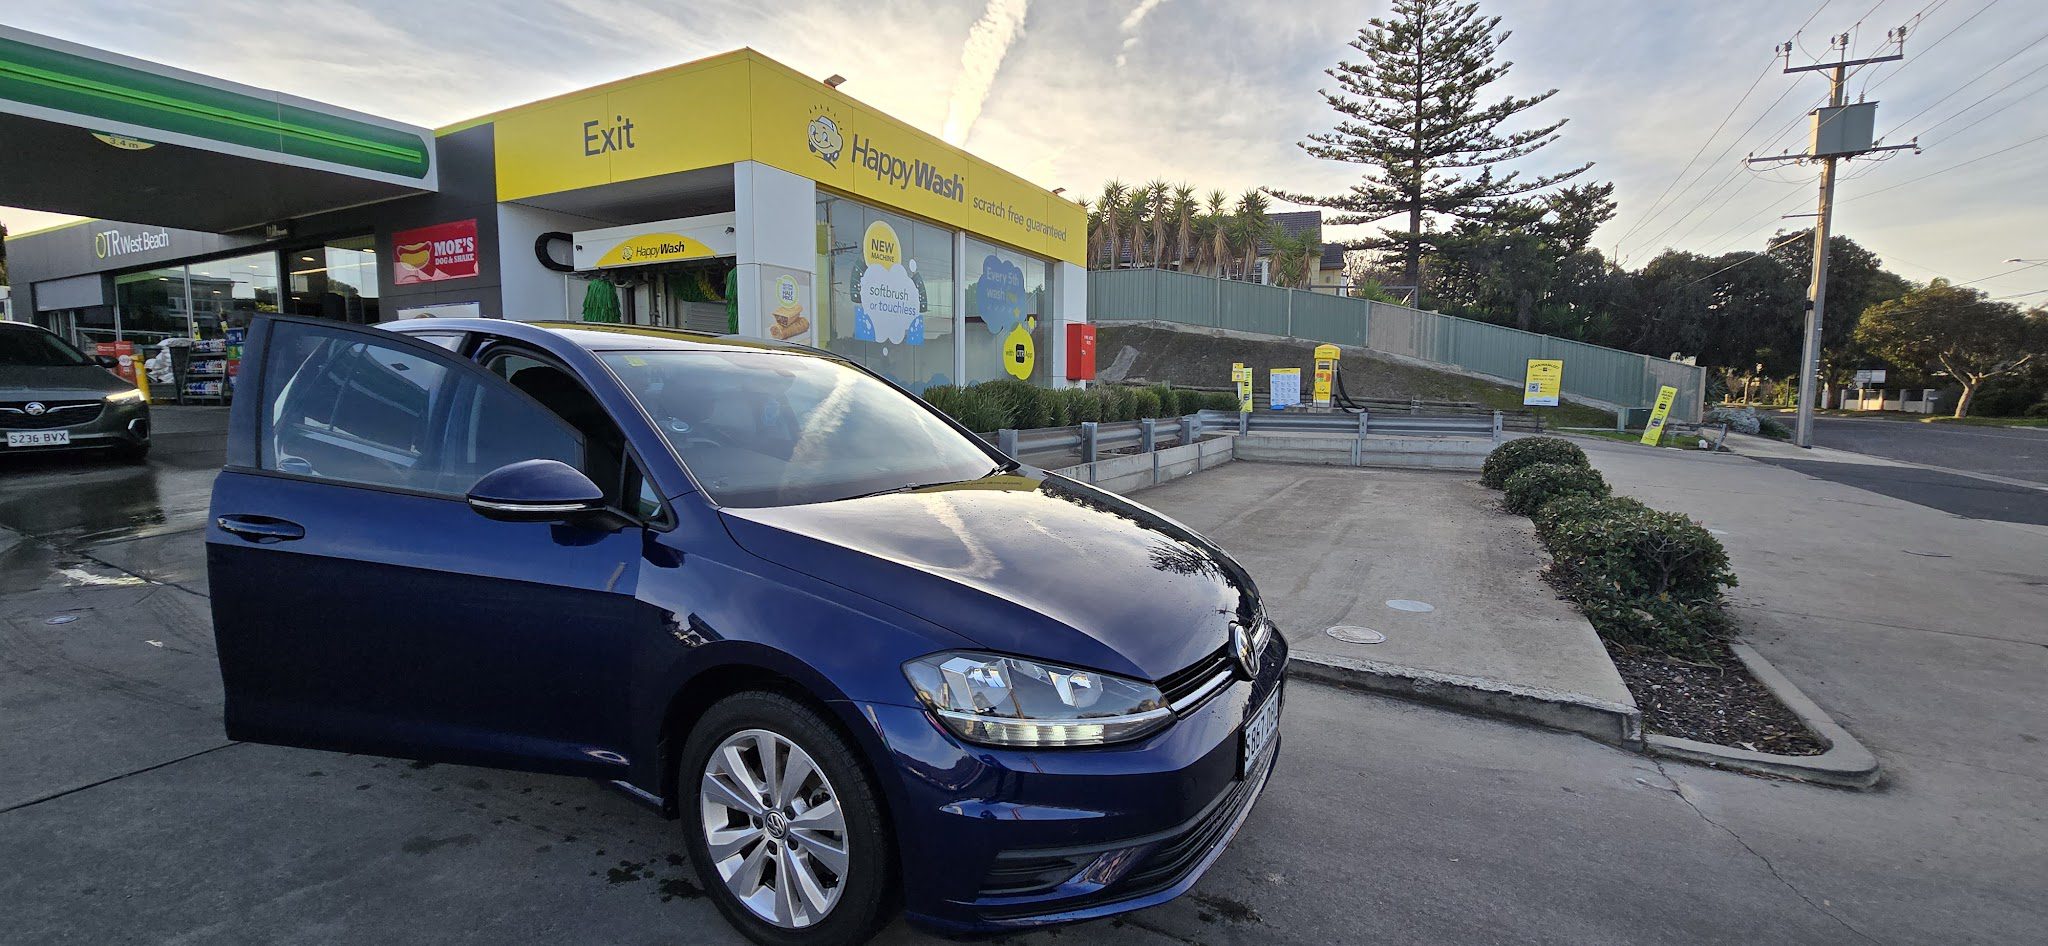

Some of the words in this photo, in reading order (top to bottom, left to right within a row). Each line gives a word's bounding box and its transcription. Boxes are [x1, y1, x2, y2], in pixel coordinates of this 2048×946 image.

[584, 115, 634, 156] Exit
[973, 196, 1005, 219] scratch
[1008, 205, 1024, 225] free
[1026, 217, 1067, 241] guaranteed
[95, 230, 121, 258] OTR
[120, 234, 143, 254] West
[143, 227, 169, 250] Beach
[434, 236, 474, 256] MOE'S
[871, 239, 895, 254] NEW
[435, 257, 448, 265] DOG
[448, 255, 454, 264] &
[454, 253, 474, 263] SHAKE
[871, 252, 895, 263] MACHINE
[987, 266, 1007, 285] Every
[870, 284, 909, 301] softbrush
[870, 301, 878, 310] or
[879, 300, 917, 316] touchless
[10, 434, 39, 444] S236
[43, 432, 66, 442] BVX
